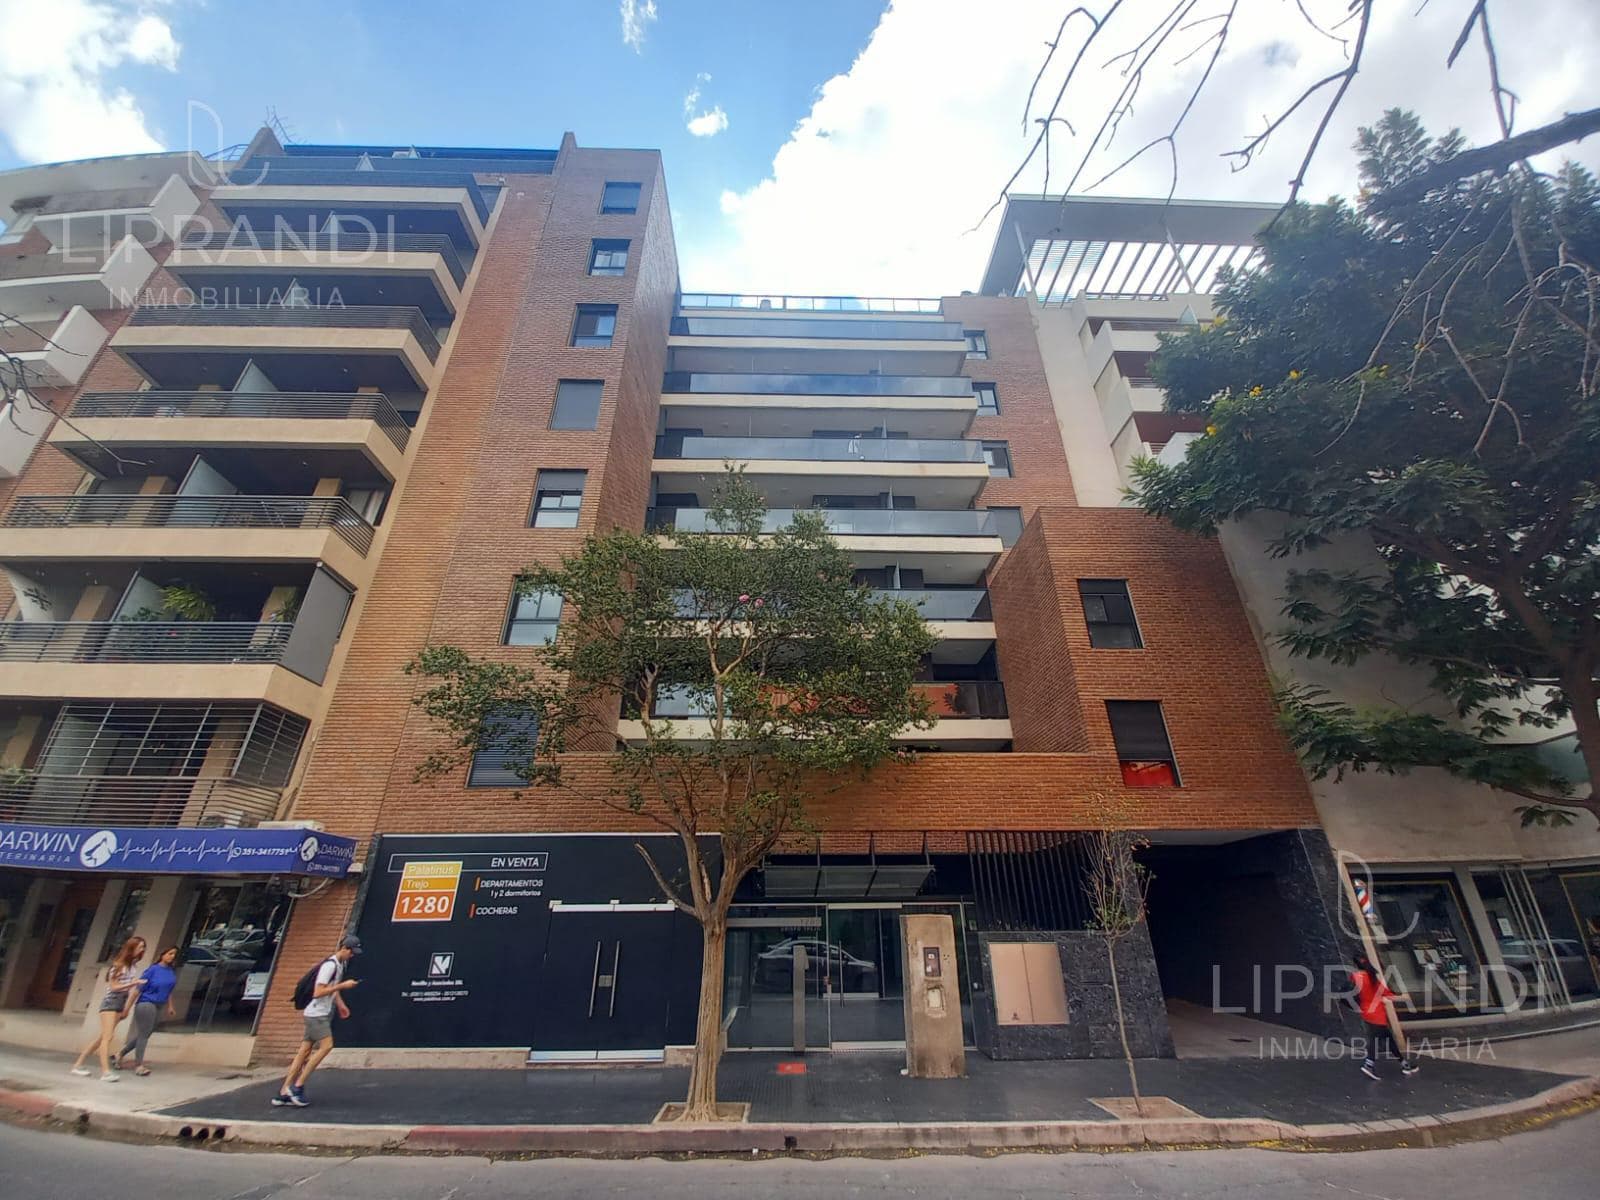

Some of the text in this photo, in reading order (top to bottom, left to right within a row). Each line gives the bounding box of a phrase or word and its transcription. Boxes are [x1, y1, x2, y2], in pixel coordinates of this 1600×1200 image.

[0, 830, 80, 852] ARWIN
[491, 857, 539, 867] EN VENTA
[406, 879, 430, 890] Trejo
[480, 879, 544, 888] DEPARTAMENTOS
[401, 895, 450, 914] 1280
[476, 906, 519, 915] COCHERAS
